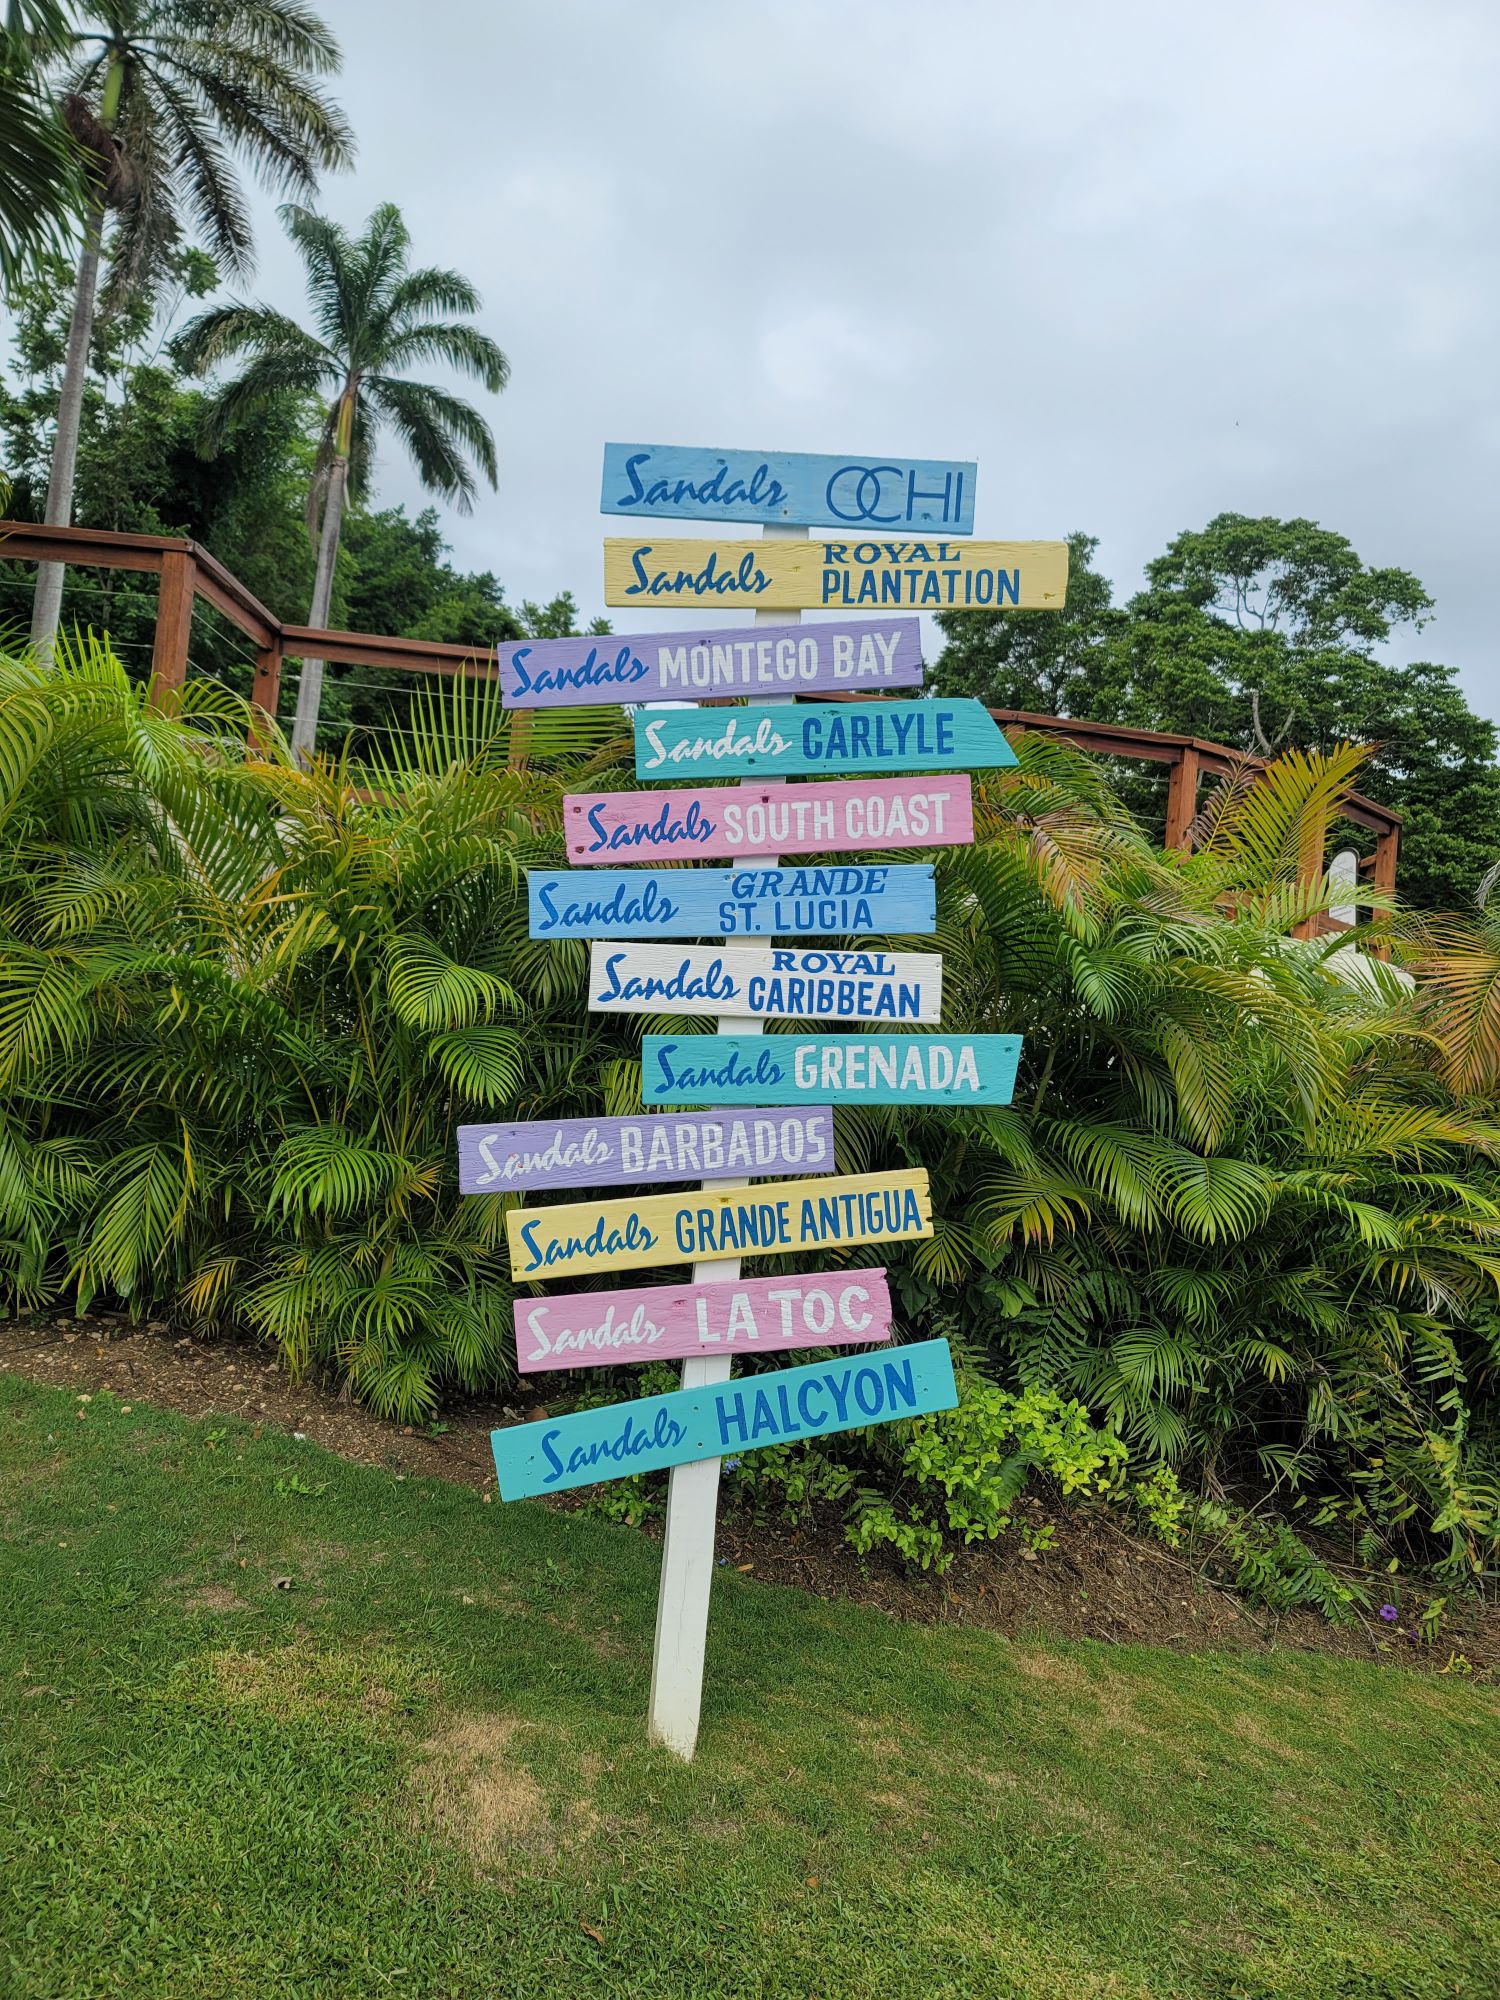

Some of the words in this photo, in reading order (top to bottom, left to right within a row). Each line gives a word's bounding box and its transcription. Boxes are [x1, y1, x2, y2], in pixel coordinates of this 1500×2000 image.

[617, 454, 788, 506] Sandals
[826, 465, 963, 523] OCHI
[625, 547, 773, 595] Sandals
[823, 543, 961, 564] ROYAL
[822, 569, 1020, 605] PLANTATION
[511, 647, 649, 697] Sandals
[659, 638, 818, 687] MONTEGO
[833, 631, 901, 678] BAY
[644, 718, 793, 769] Sandals
[802, 713, 954, 759] CARLYLE
[587, 800, 717, 852] Sandals
[724, 797, 836, 845] SOUTH
[845, 793, 951, 840] COAST
[538, 880, 679, 930] Sandals
[731, 868, 889, 898] GRANDE
[719, 902, 761, 933] ST.
[775, 899, 873, 929] LUCIA
[597, 953, 741, 1002] Sandals
[771, 951, 896, 976] ROYAL
[748, 977, 921, 1018] CARIBBEAN
[654, 1044, 785, 1093] Sandals
[794, 1044, 980, 1091] GRENADA
[475, 1129, 613, 1185] Sandals
[620, 1116, 826, 1173] BARBADOS
[521, 1213, 659, 1272] Sandals
[675, 1202, 792, 1254] GRANDE
[800, 1188, 923, 1240] ANTIGUA
[526, 1304, 665, 1361] Sandals
[696, 1291, 760, 1343] LA
[768, 1285, 873, 1338] TOC
[542, 1407, 687, 1484] Sandals
[715, 1358, 917, 1446] HALCYON
